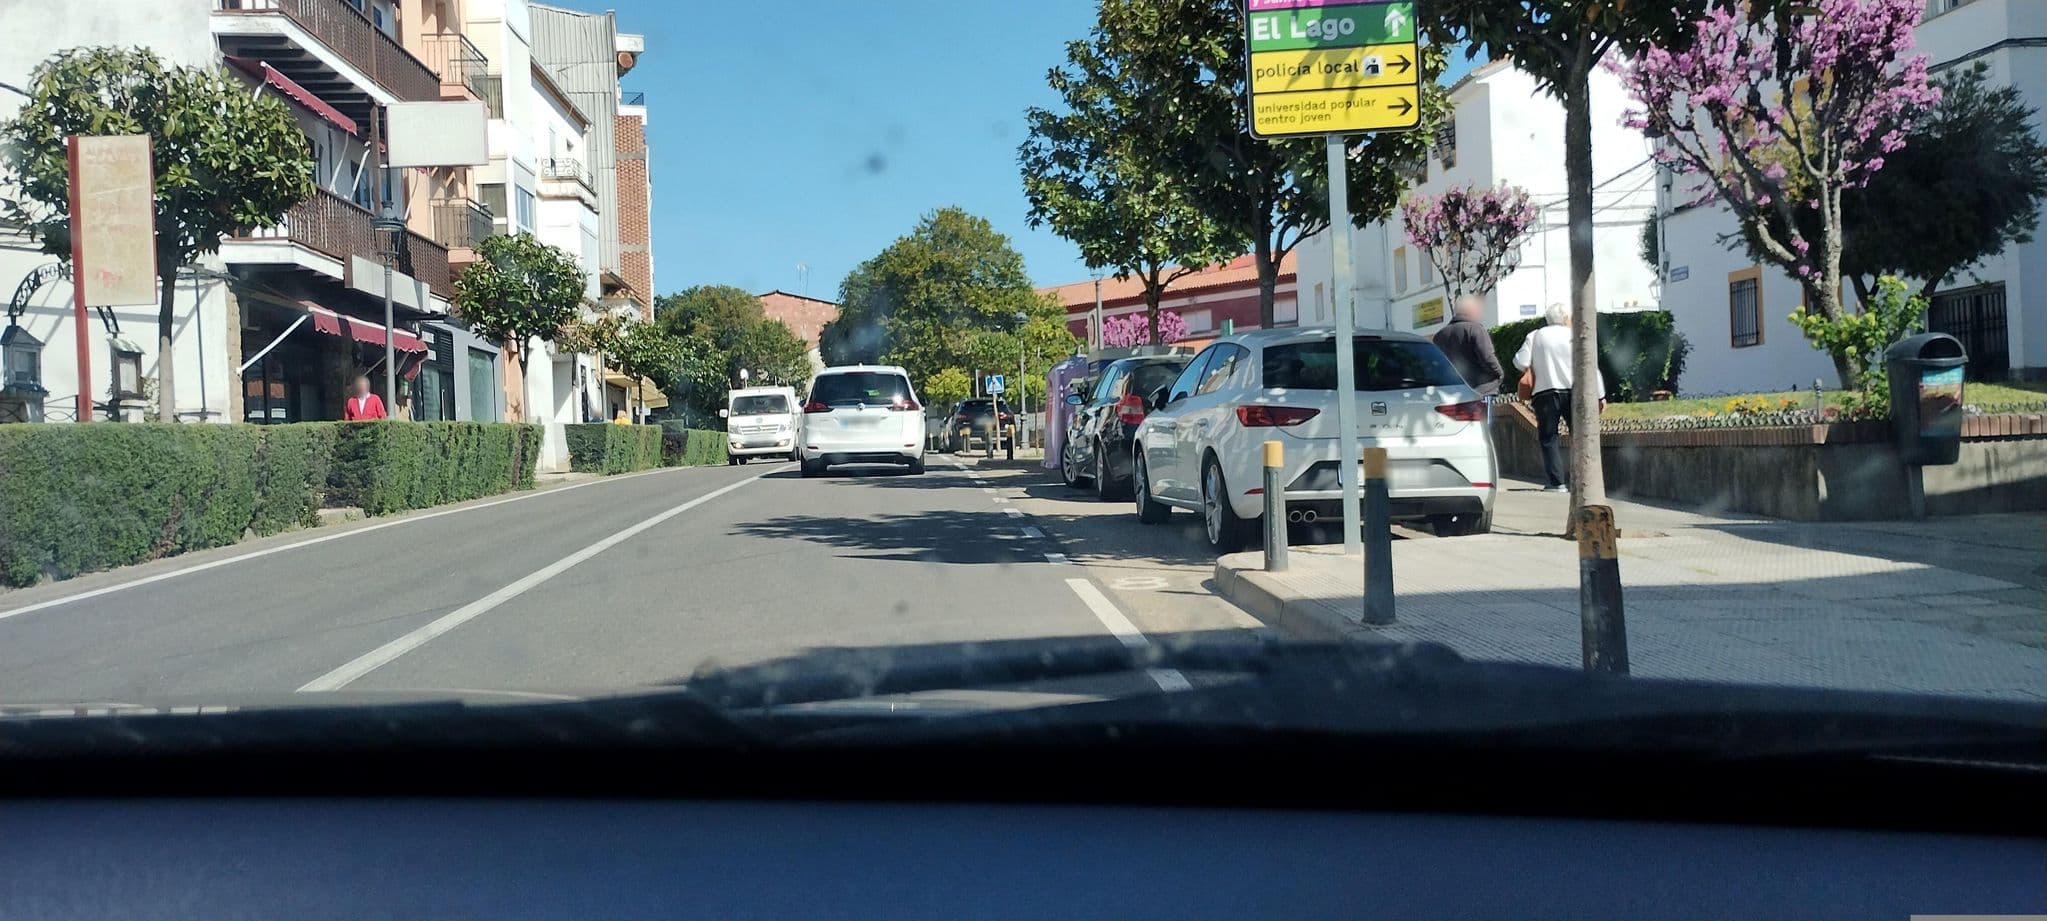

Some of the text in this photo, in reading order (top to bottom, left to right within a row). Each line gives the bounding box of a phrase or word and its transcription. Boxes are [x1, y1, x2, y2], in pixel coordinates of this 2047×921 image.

[1252, 14, 1356, 41] El Lago
[1256, 59, 1359, 82] policía local
[1257, 97, 1377, 114] universidad popular
[1258, 112, 1332, 125] centro joven
